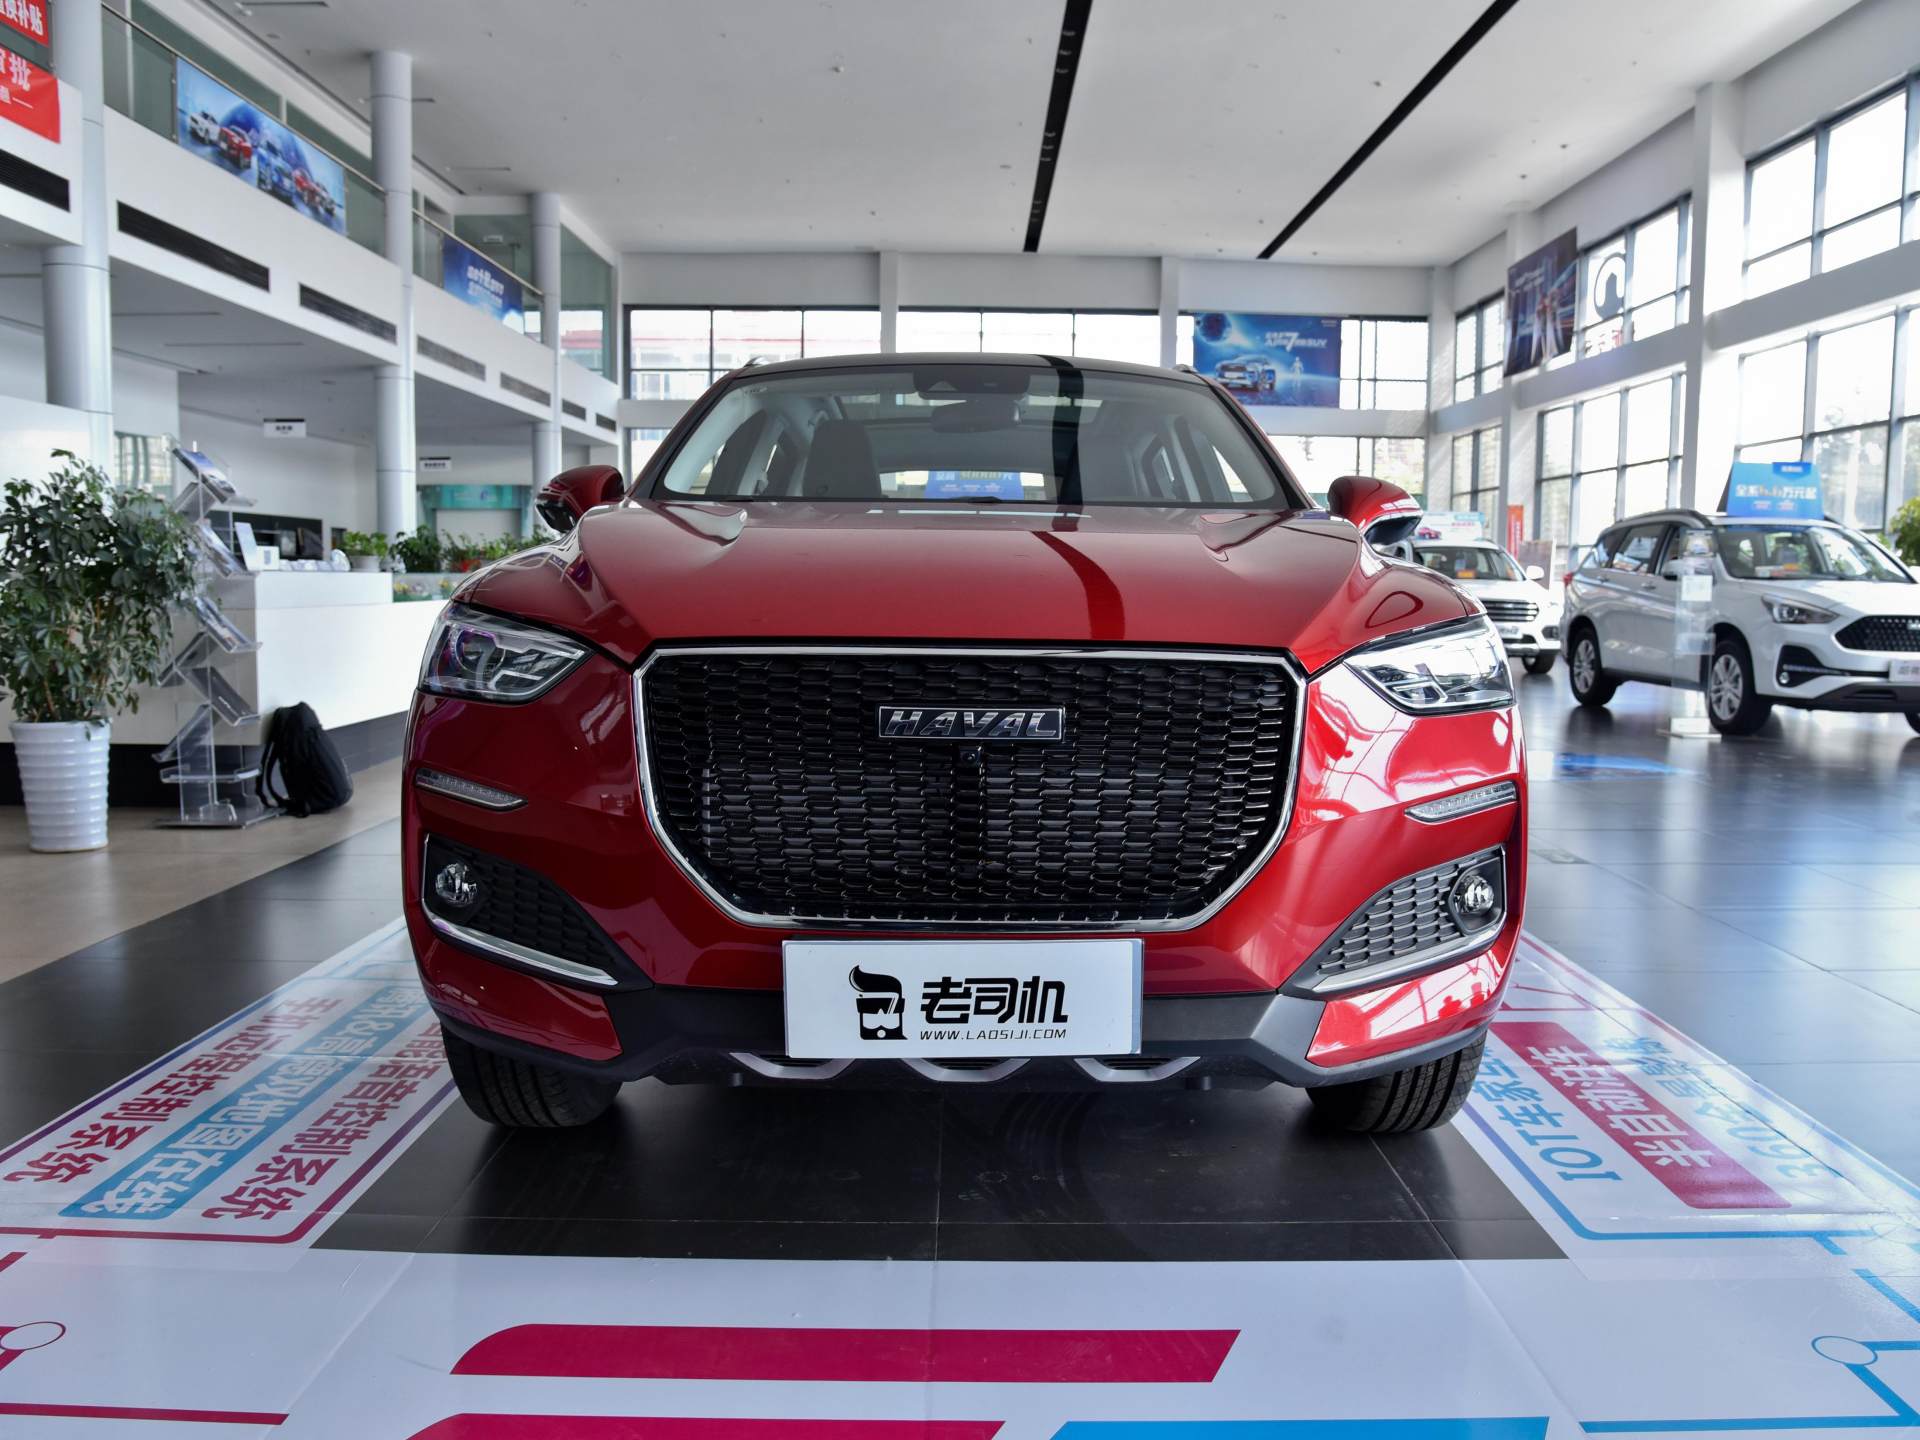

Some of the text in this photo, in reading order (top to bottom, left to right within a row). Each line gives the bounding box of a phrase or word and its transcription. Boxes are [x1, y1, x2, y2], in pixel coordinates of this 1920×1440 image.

[884, 710, 1057, 737] HAVAL
[920, 975, 1069, 1024] 老司机
[919, 1028, 1068, 1041] WWW.LAOSIJI.COM
[3, 996, 345, 1184] 手机远程控制系统
[1527, 1045, 1718, 1169] 半自动泊车
